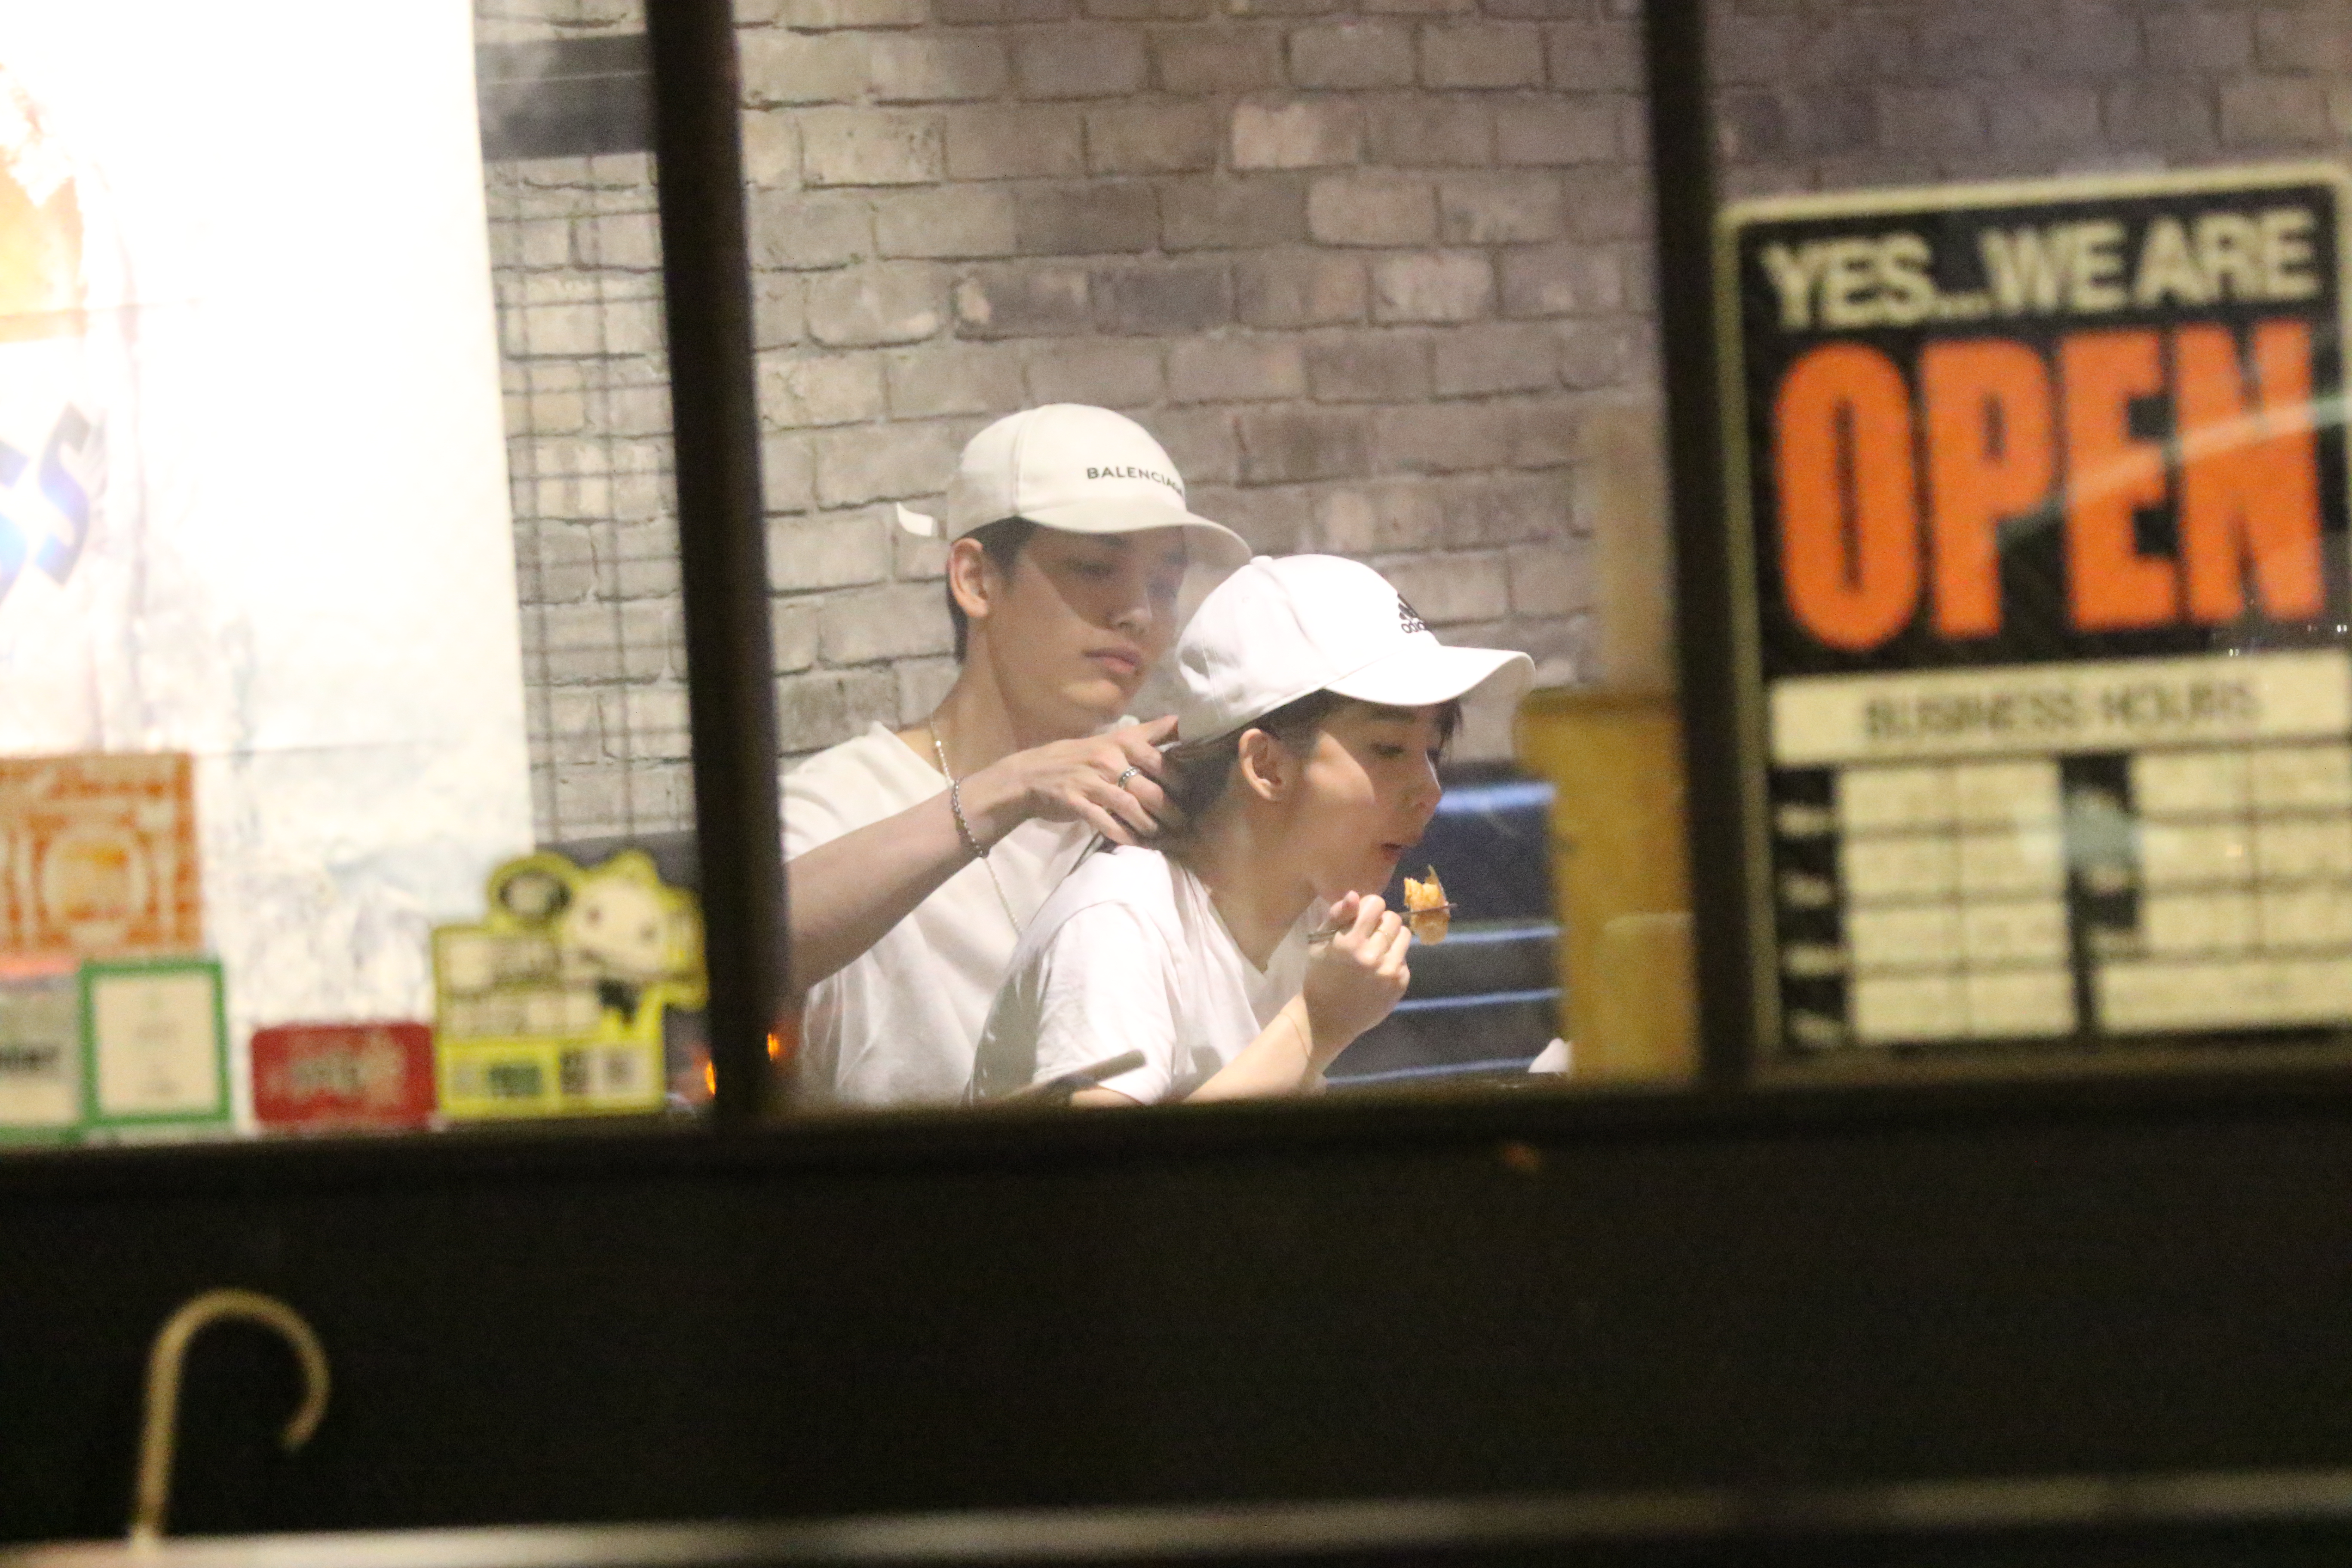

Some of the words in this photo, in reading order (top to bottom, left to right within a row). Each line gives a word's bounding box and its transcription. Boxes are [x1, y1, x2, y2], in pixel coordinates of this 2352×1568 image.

[1981, 218, 2128, 315] WE
[2133, 206, 2321, 307] ARE
[1773, 317, 2322, 652] OPEN
